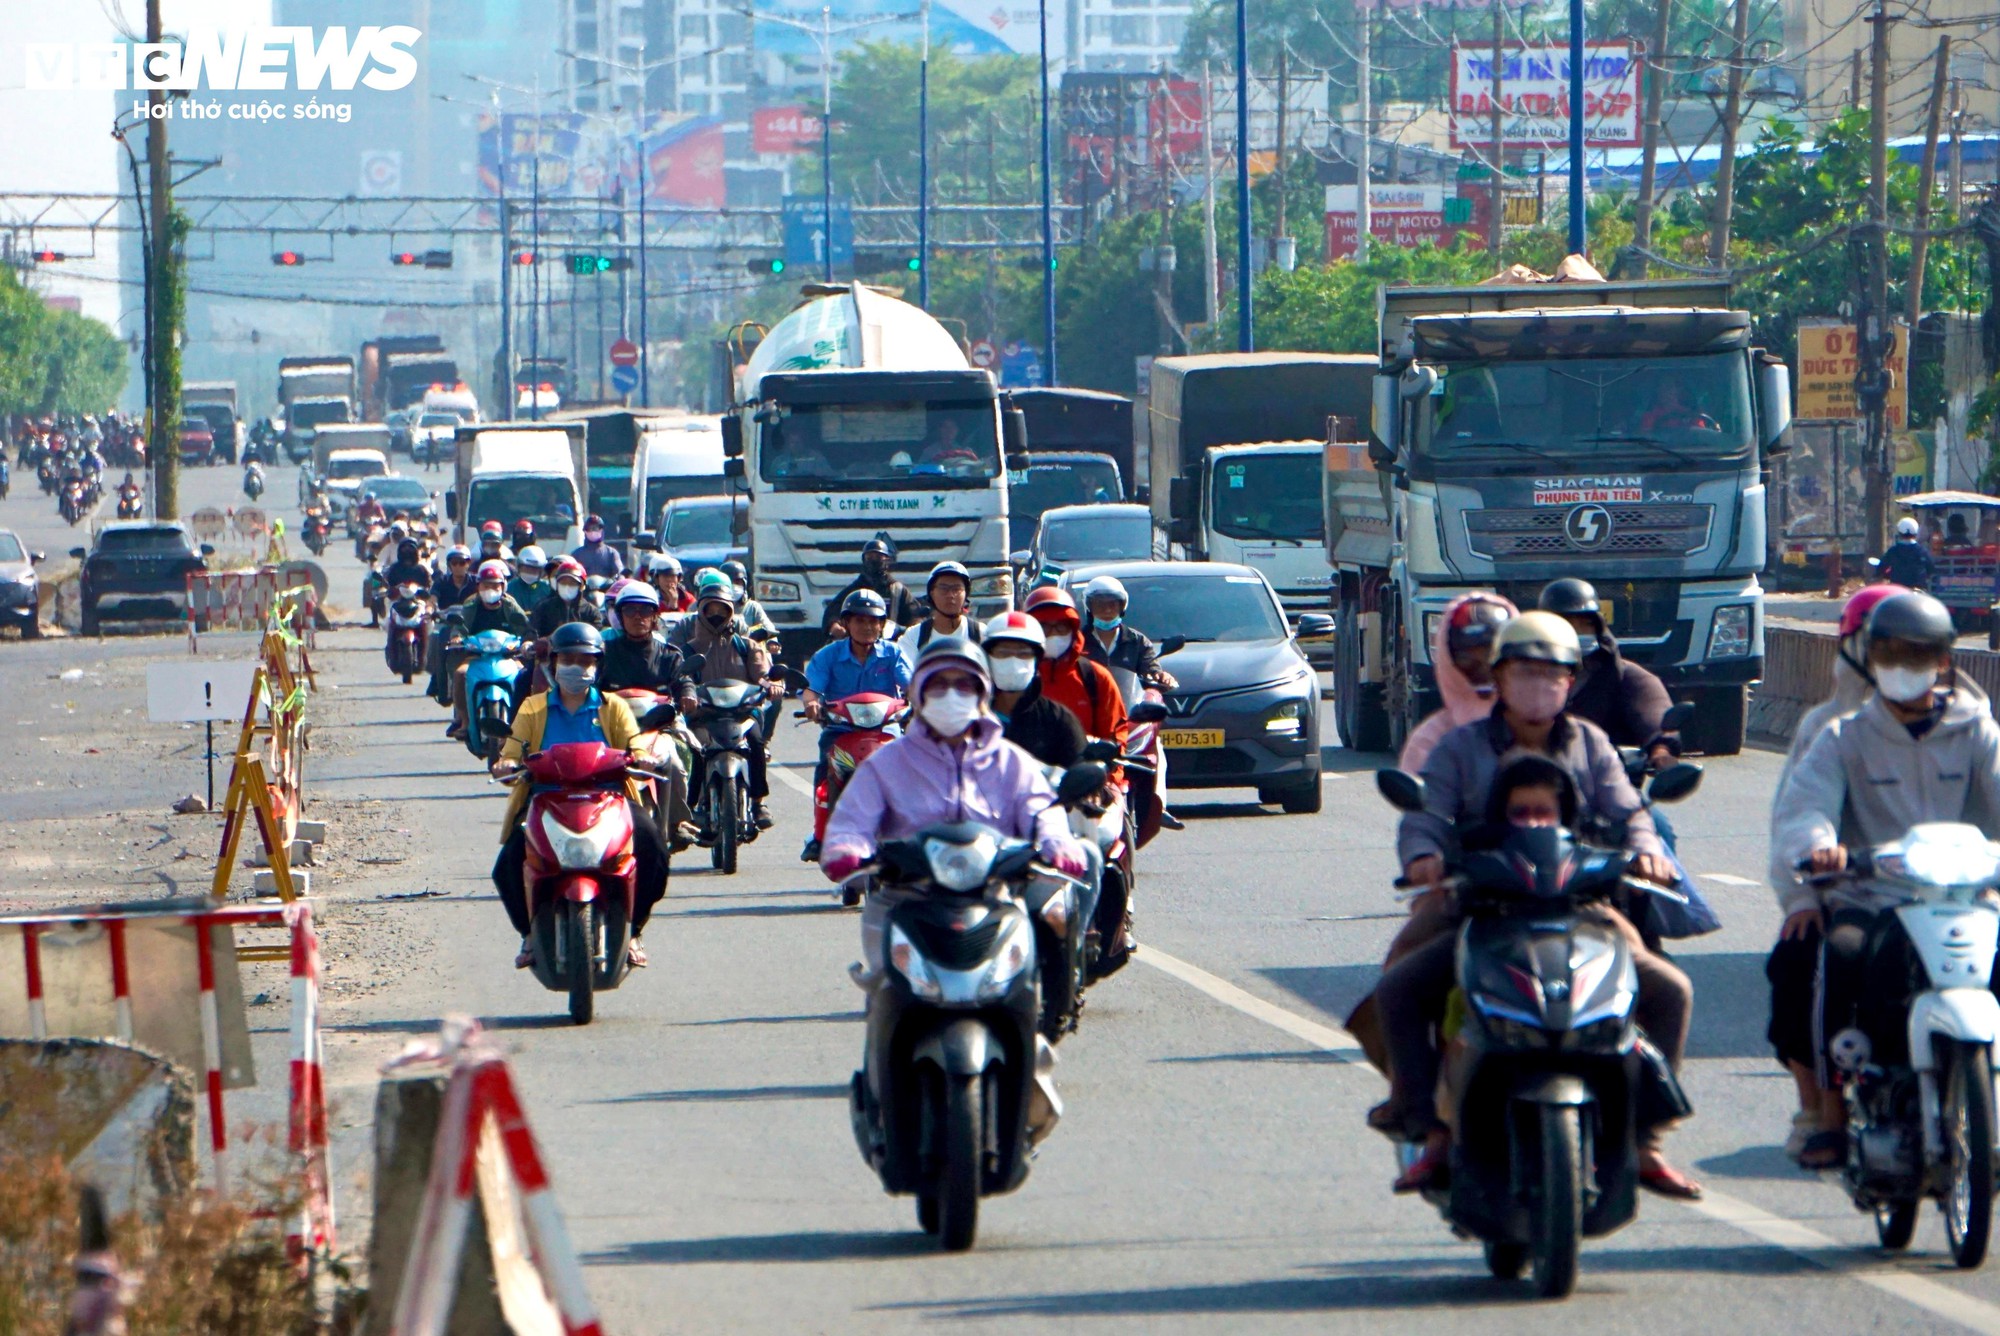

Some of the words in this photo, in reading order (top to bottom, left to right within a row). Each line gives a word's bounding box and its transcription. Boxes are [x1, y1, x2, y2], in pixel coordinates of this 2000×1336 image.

[1534, 477, 1642, 489] SHACMAN
[1536, 491, 1580, 505] PHỤNG
[1584, 487, 1608, 502] TÂN
[839, 499, 856, 511] C.TY
[897, 498, 919, 510] XANH
[1296, 576, 1332, 585] ISUZ
[1160, 732, 1216, 746] H-075.31
